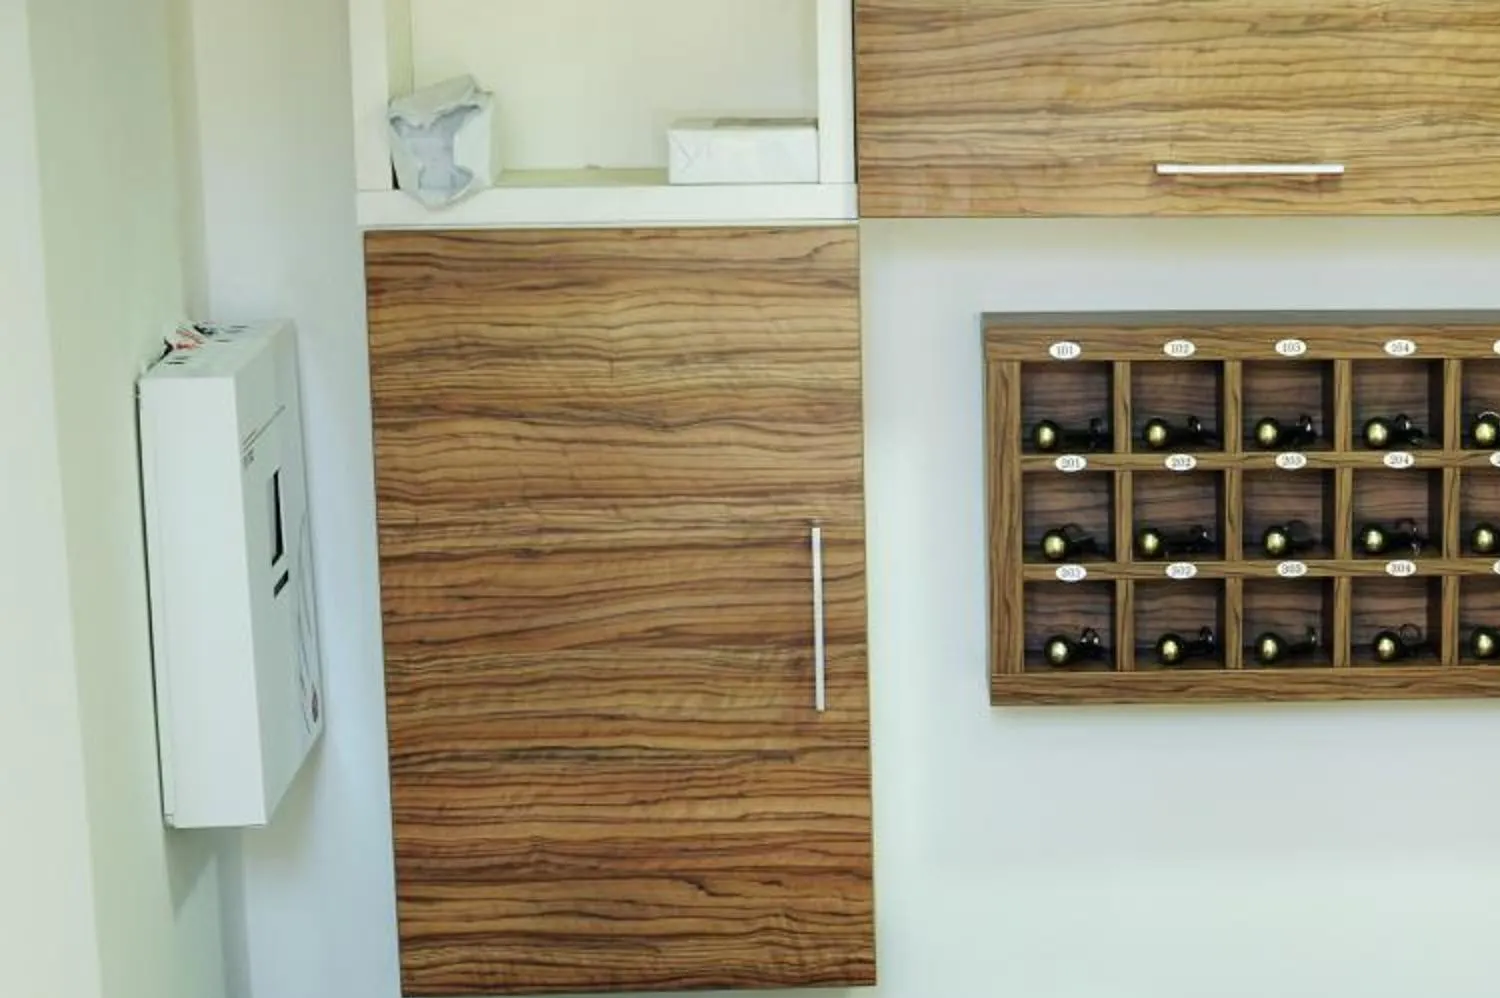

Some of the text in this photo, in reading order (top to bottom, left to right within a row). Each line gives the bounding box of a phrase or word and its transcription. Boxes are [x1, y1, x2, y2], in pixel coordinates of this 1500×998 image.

[1056, 345, 1073, 355] 101
[1171, 343, 1190, 354] 102
[1061, 458, 1080, 468] 201
